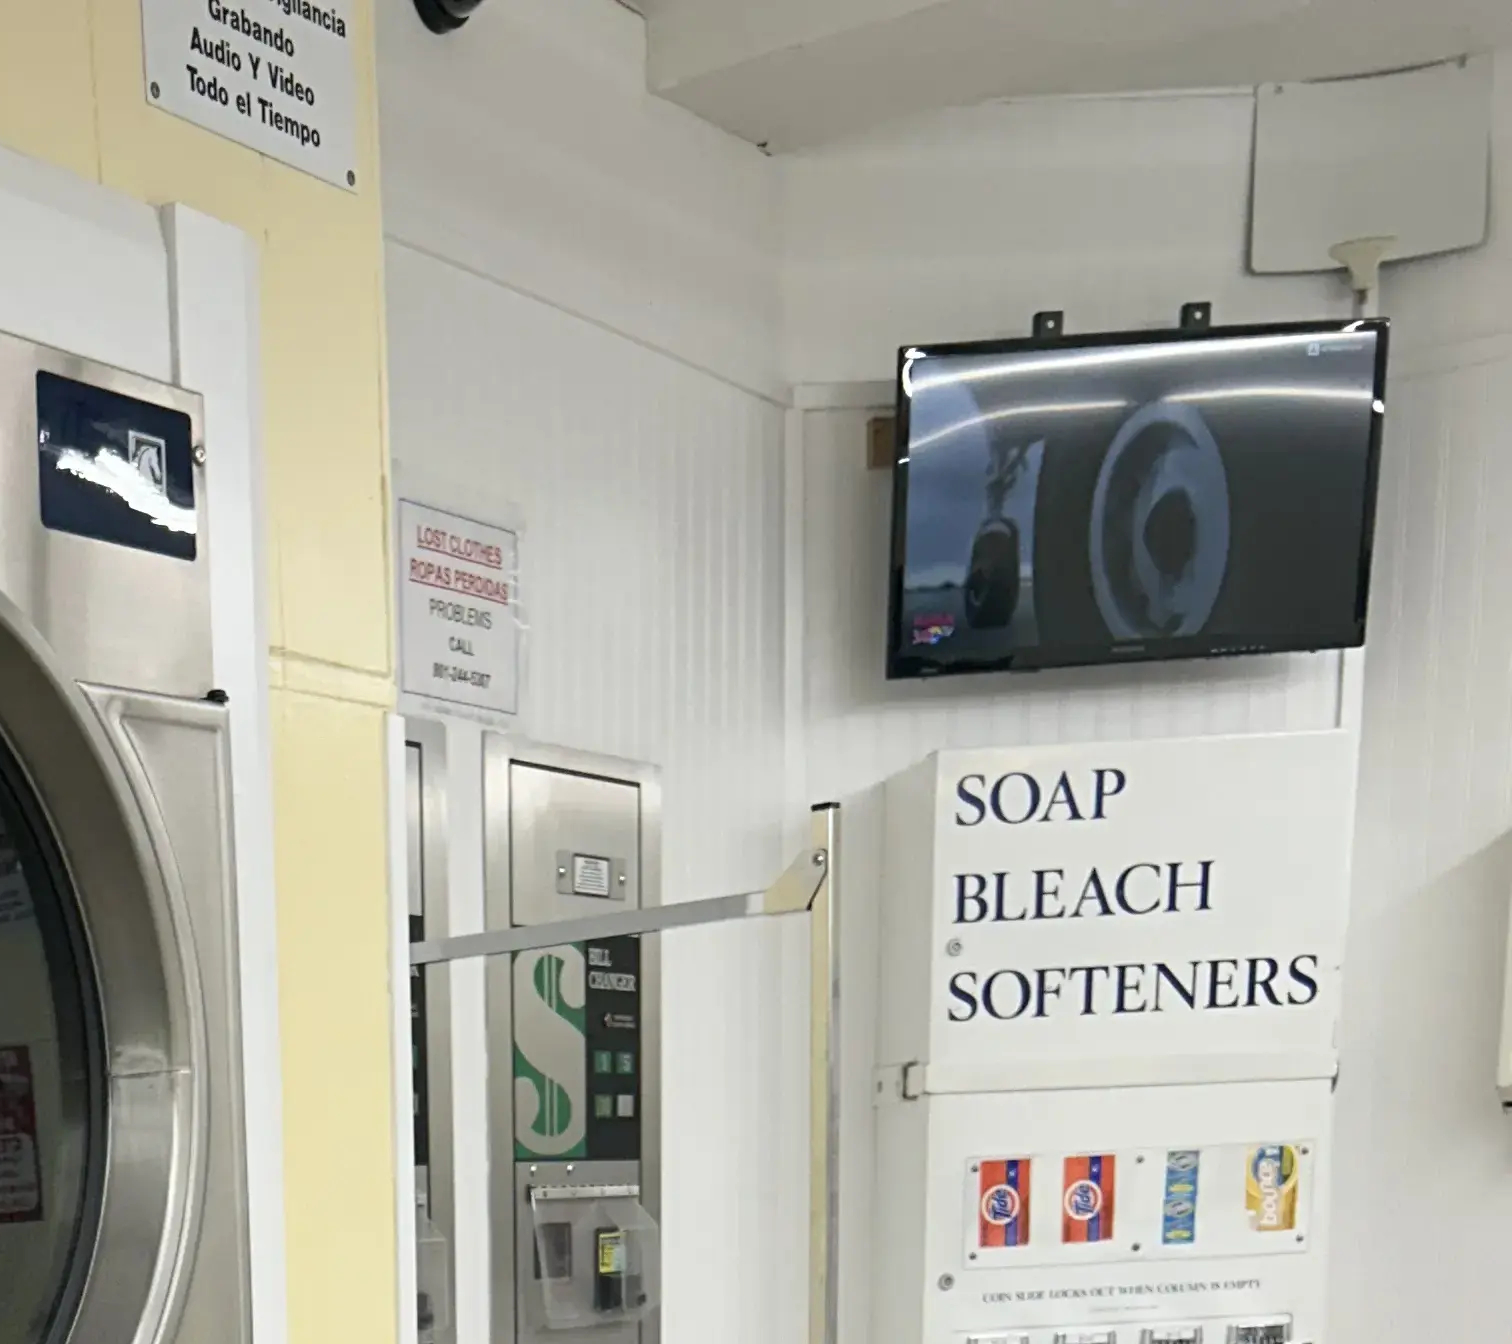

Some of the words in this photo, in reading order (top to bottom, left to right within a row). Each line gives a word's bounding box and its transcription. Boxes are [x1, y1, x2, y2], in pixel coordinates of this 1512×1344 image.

[207, 0, 295, 57] Grabando
[269, 0, 346, 38] gilancia
[190, 26, 241, 71] Audio
[248, 52, 260, 80] Y
[268, 62, 315, 106] Video
[186, 64, 229, 106] Todo
[236, 92, 251, 117] el
[257, 97, 320, 147] Tiempo
[410, 558, 451, 585] ROPAS
[417, 525, 447, 549] LOST
[449, 535, 501, 565] CLOTHES
[449, 636, 475, 656] CALL
[955, 768, 1126, 826] SOAP
[952, 860, 1215, 924] BLEACH
[947, 953, 1319, 1021] SOFTENERS
